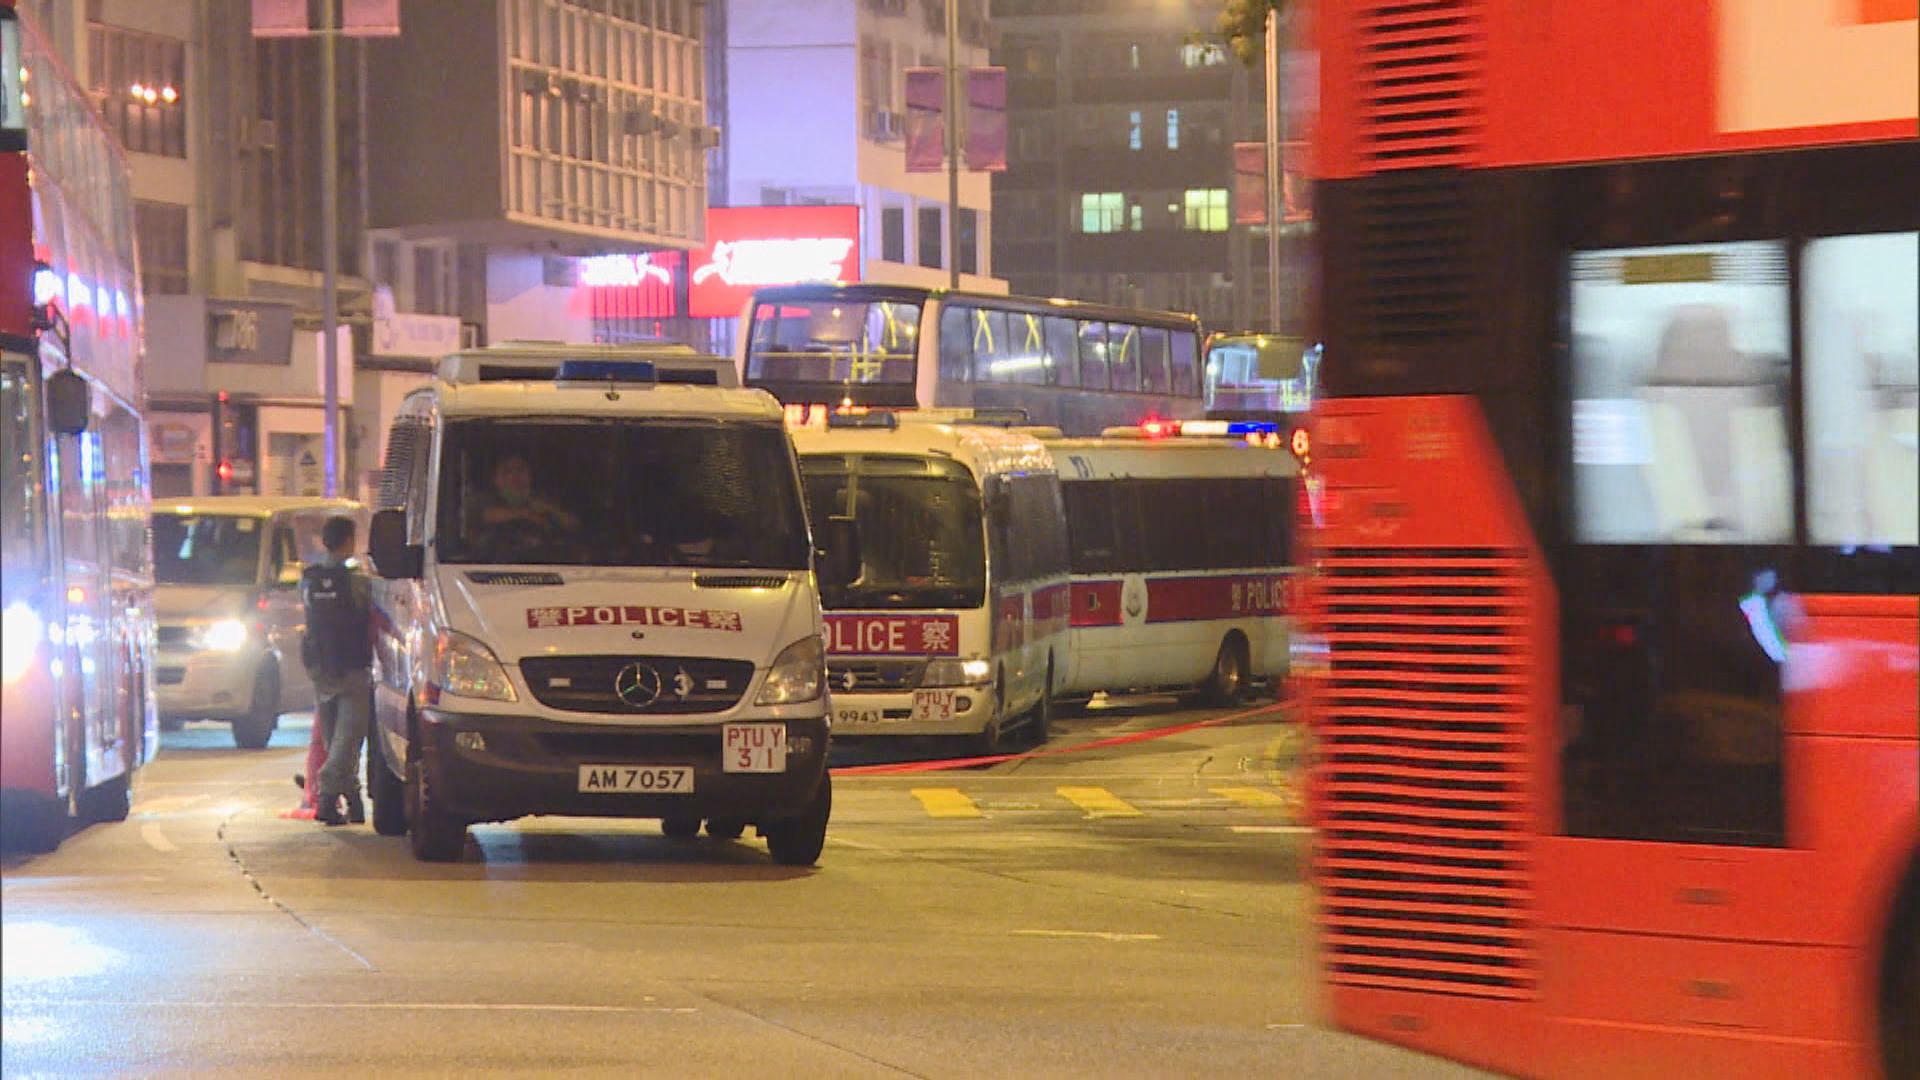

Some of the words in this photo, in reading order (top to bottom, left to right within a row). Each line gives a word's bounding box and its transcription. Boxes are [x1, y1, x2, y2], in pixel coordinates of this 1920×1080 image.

[921, 620, 951, 650] 察
[839, 710, 880, 723] 9943
[727, 727, 764, 748] PTU
[587, 771, 618, 789] AM
[624, 770, 685, 789] 7057
